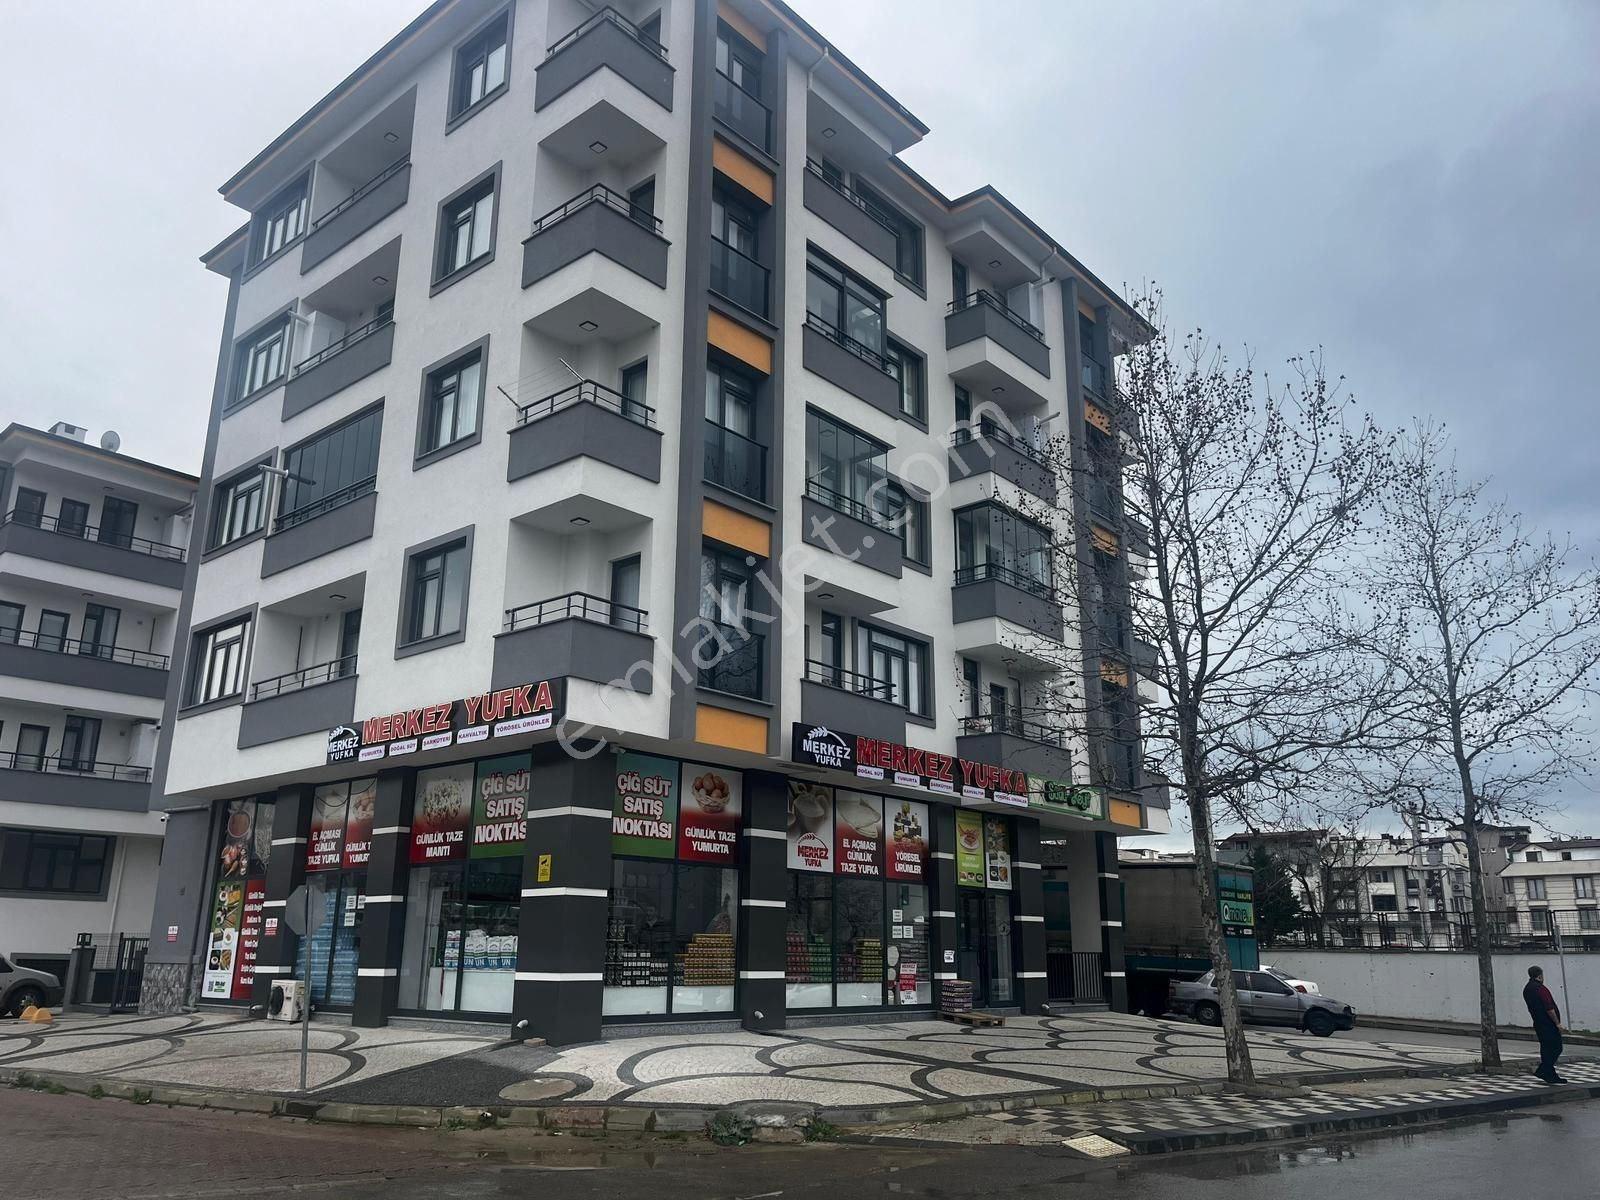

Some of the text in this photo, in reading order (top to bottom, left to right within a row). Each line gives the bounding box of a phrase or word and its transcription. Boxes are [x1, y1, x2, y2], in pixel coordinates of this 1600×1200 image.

[362, 680, 553, 745] MERKEZ YUFKA
[523, 718, 550, 728] ÜRÜNLER
[327, 736, 360, 753] MERKEZ
[802, 738, 851, 760] MERKEZ
[331, 748, 354, 761] YUFKA
[814, 753, 842, 768] YUFKA
[856, 735, 1028, 797] MERKEZ YUFKA
[481, 772, 504, 799] ÇİĞ
[616, 772, 672, 796] ÇİĞ SÜT
[486, 797, 525, 820] SATIŞ
[623, 796, 664, 820] SATIŞ
[612, 816, 672, 839] NOKTASI
[684, 826, 736, 842] GÜNLÜK TAZE
[312, 829, 341, 842] EL AÇMASI
[416, 830, 464, 845] GÜNLÜK TAZE
[314, 842, 336, 853] GÜNLÜK
[346, 842, 367, 852] GÜNLÜK
[692, 841, 729, 854] YUMURTA
[842, 838, 876, 851] EL AÇMASI
[426, 846, 450, 858] MANTI
[797, 845, 829, 860] MERKEZ
[847, 850, 872, 862] GÜNLÜK
[895, 851, 920, 863] YÖRESEL
[308, 854, 340, 865] TAZE YUFKA
[804, 857, 822, 868] YUFKA
[841, 862, 879, 875] TAZE YUFKA
[895, 862, 922, 874] ÜRÜNLER
